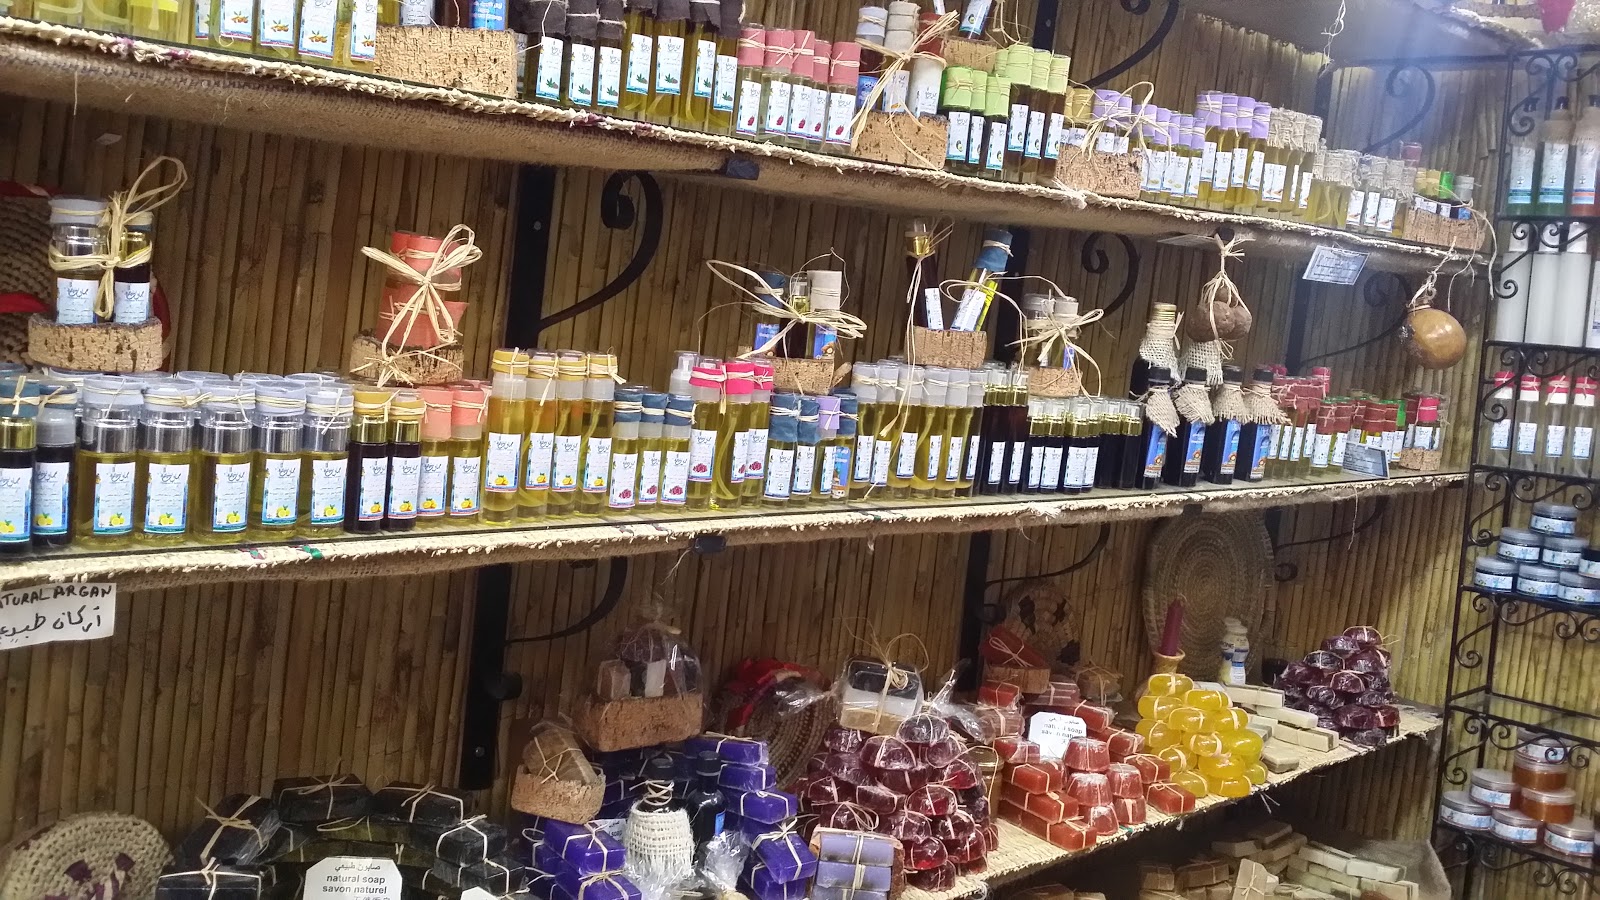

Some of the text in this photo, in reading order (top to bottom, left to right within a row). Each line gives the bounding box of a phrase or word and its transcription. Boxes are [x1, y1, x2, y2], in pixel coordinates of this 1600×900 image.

[53, 584, 112, 599] ARGAN
[326, 874, 386, 885] natural soap
[322, 884, 387, 894] savon naturel
